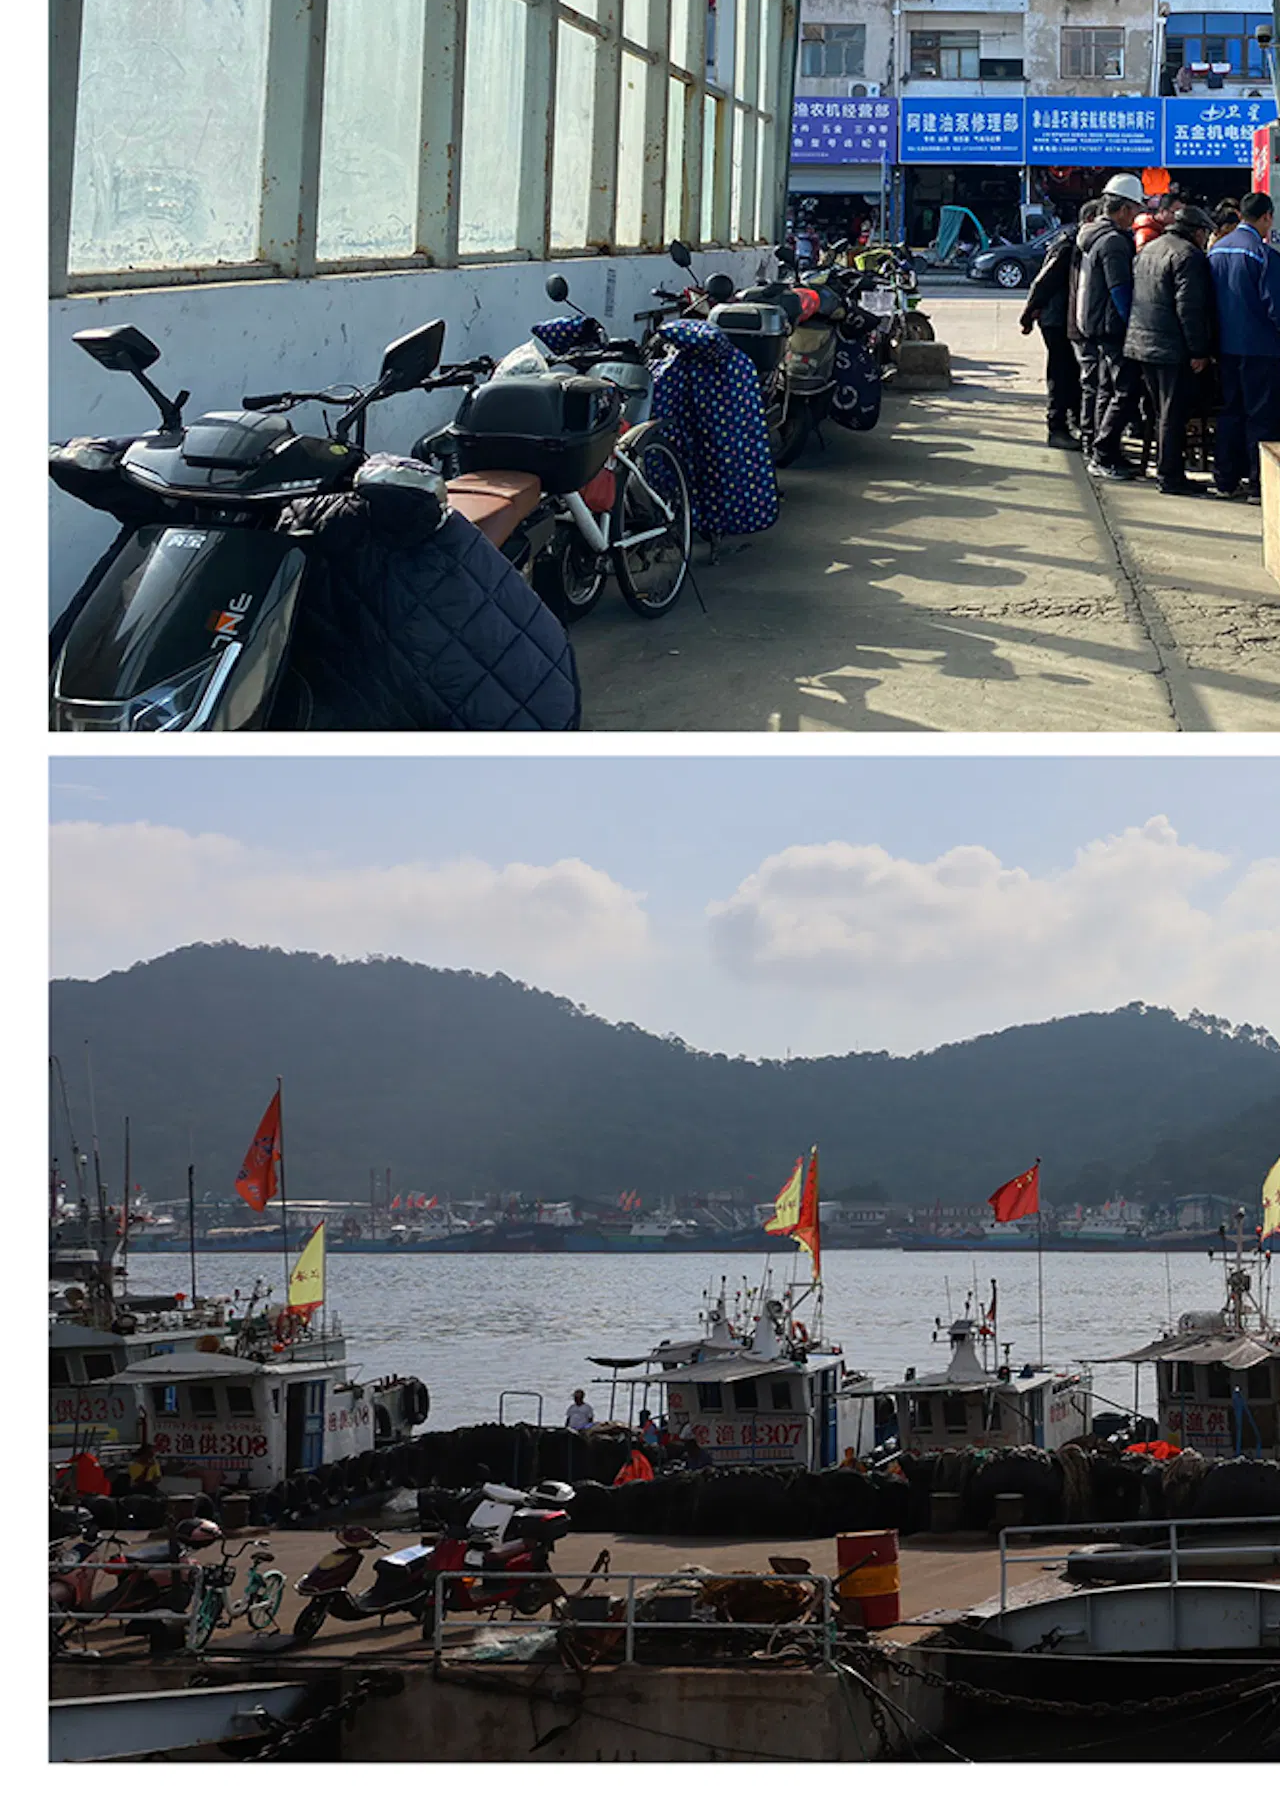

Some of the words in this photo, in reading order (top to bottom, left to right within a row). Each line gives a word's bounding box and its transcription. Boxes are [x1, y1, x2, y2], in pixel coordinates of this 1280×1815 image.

[907, 112, 1019, 133] 阿建油泵修理部
[153, 1433, 269, 1457] 象渔供308
